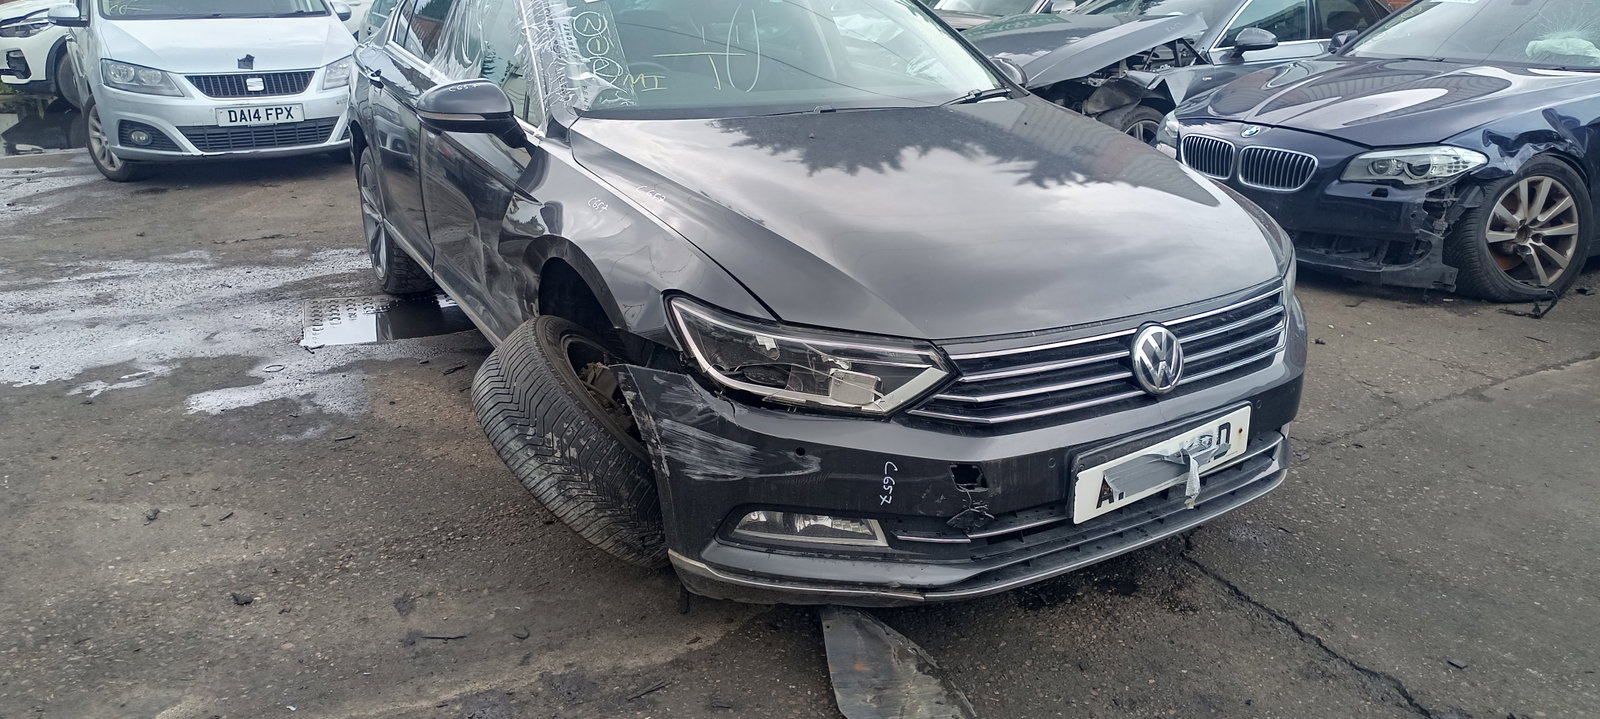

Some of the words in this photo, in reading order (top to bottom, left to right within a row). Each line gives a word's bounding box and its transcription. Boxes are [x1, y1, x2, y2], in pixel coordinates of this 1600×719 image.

[228, 108, 262, 123] DA14
[265, 106, 294, 121] FPX
[879, 461, 898, 506] C657
